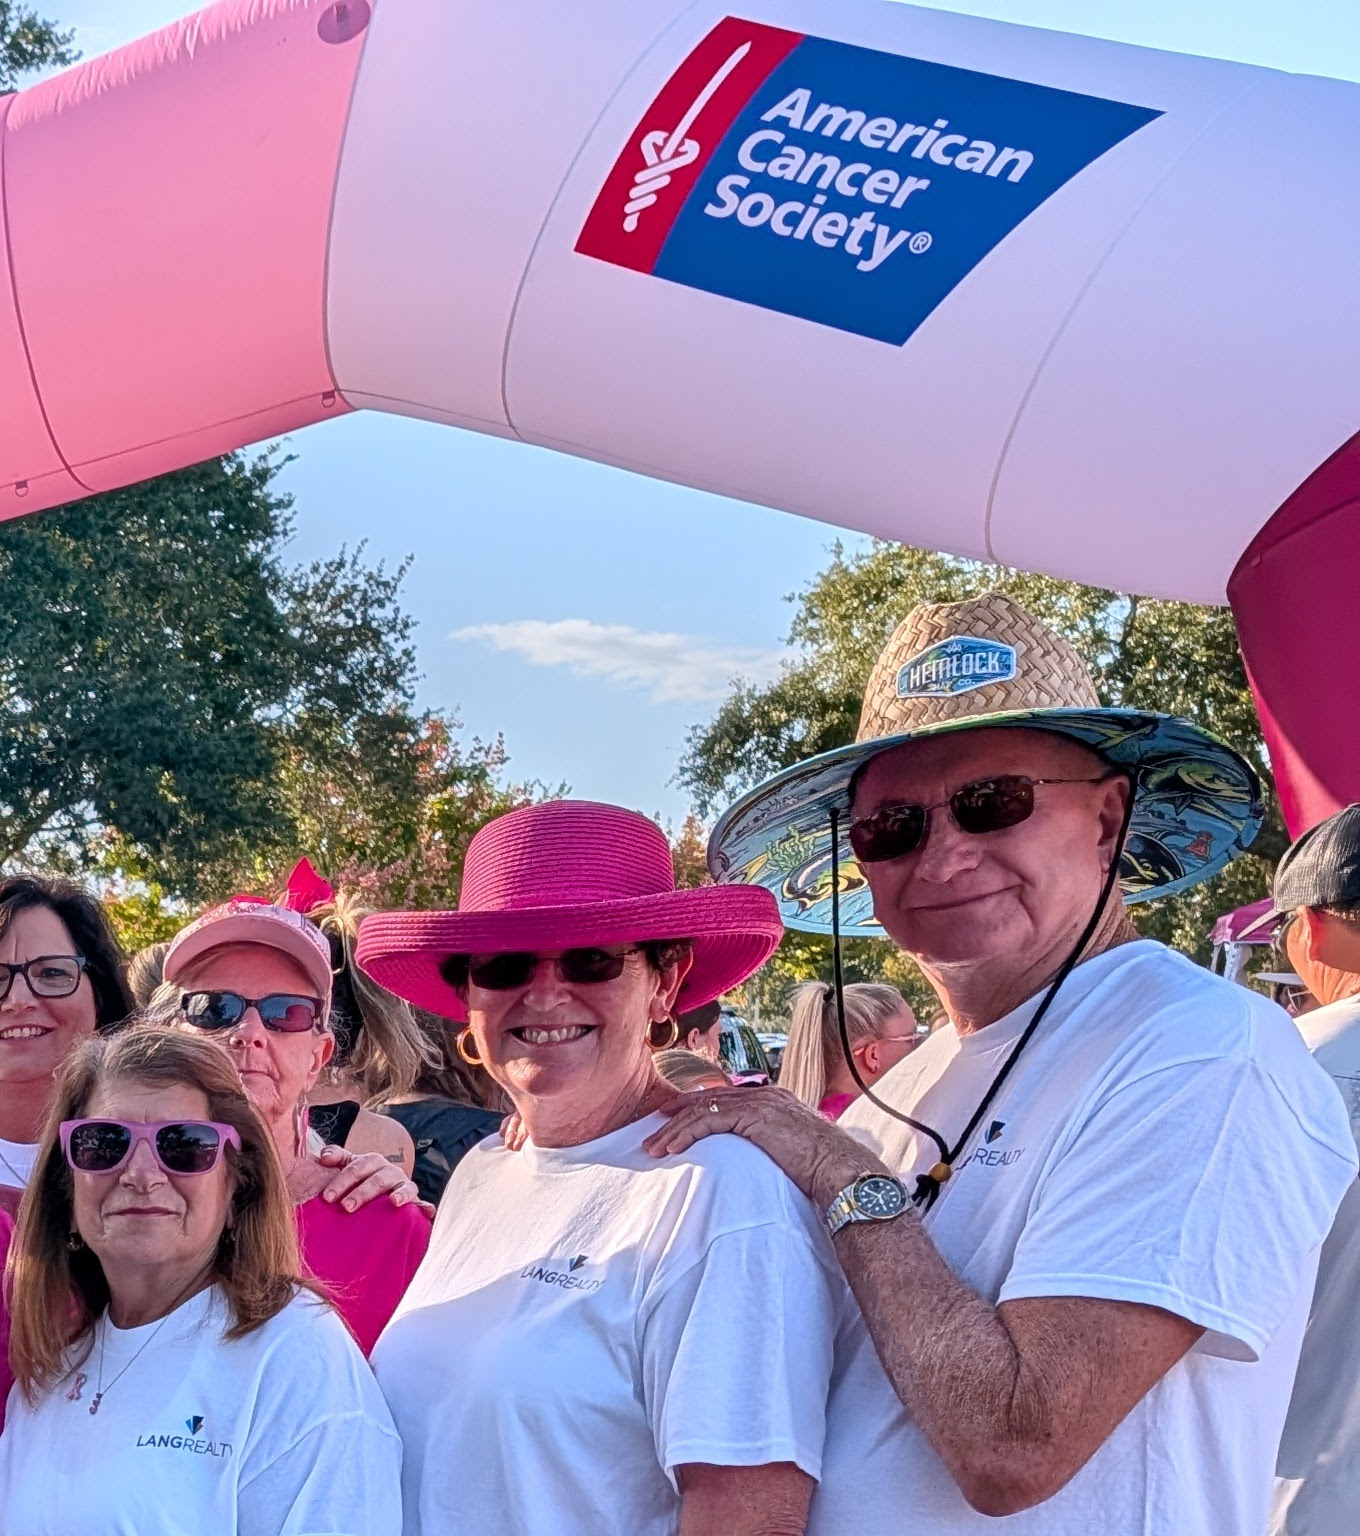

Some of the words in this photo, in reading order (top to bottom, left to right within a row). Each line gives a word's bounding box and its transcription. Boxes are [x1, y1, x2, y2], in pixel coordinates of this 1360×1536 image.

[761, 88, 1034, 184] American
[736, 129, 932, 210] Cancer
[909, 650, 1000, 690] HEMLOCK
[520, 1265, 606, 1293] LANGREALTY
